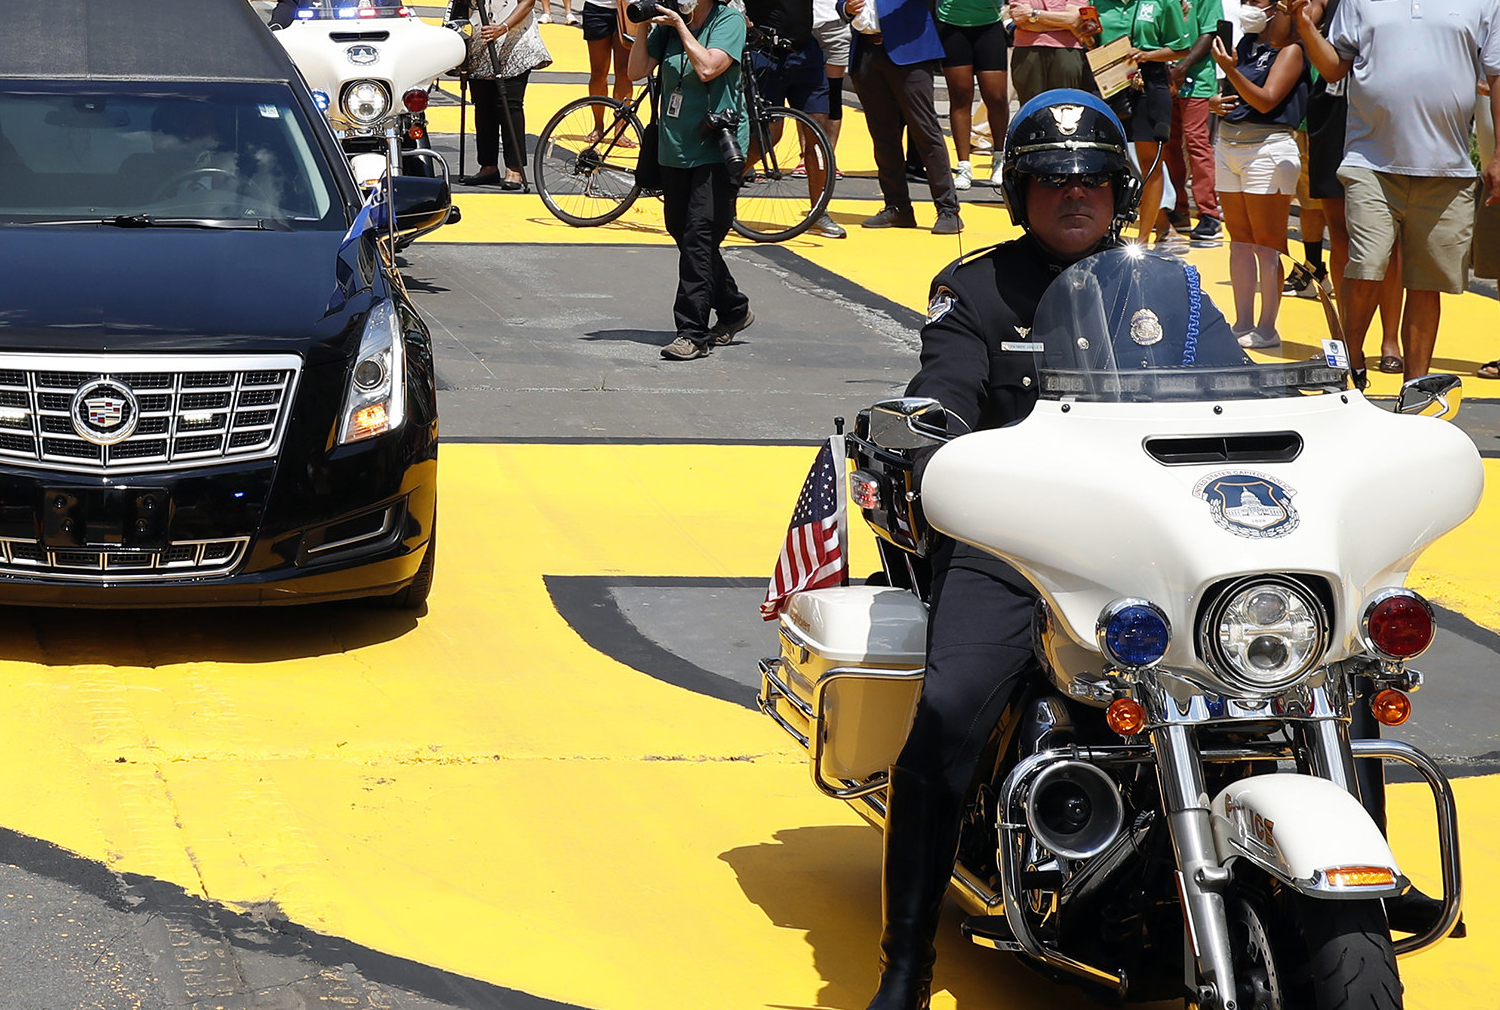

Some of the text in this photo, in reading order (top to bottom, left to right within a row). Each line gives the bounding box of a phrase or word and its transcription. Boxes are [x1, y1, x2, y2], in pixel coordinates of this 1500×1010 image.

[1194, 470, 1294, 496] UNITED STATES CAPITOL POLICE
